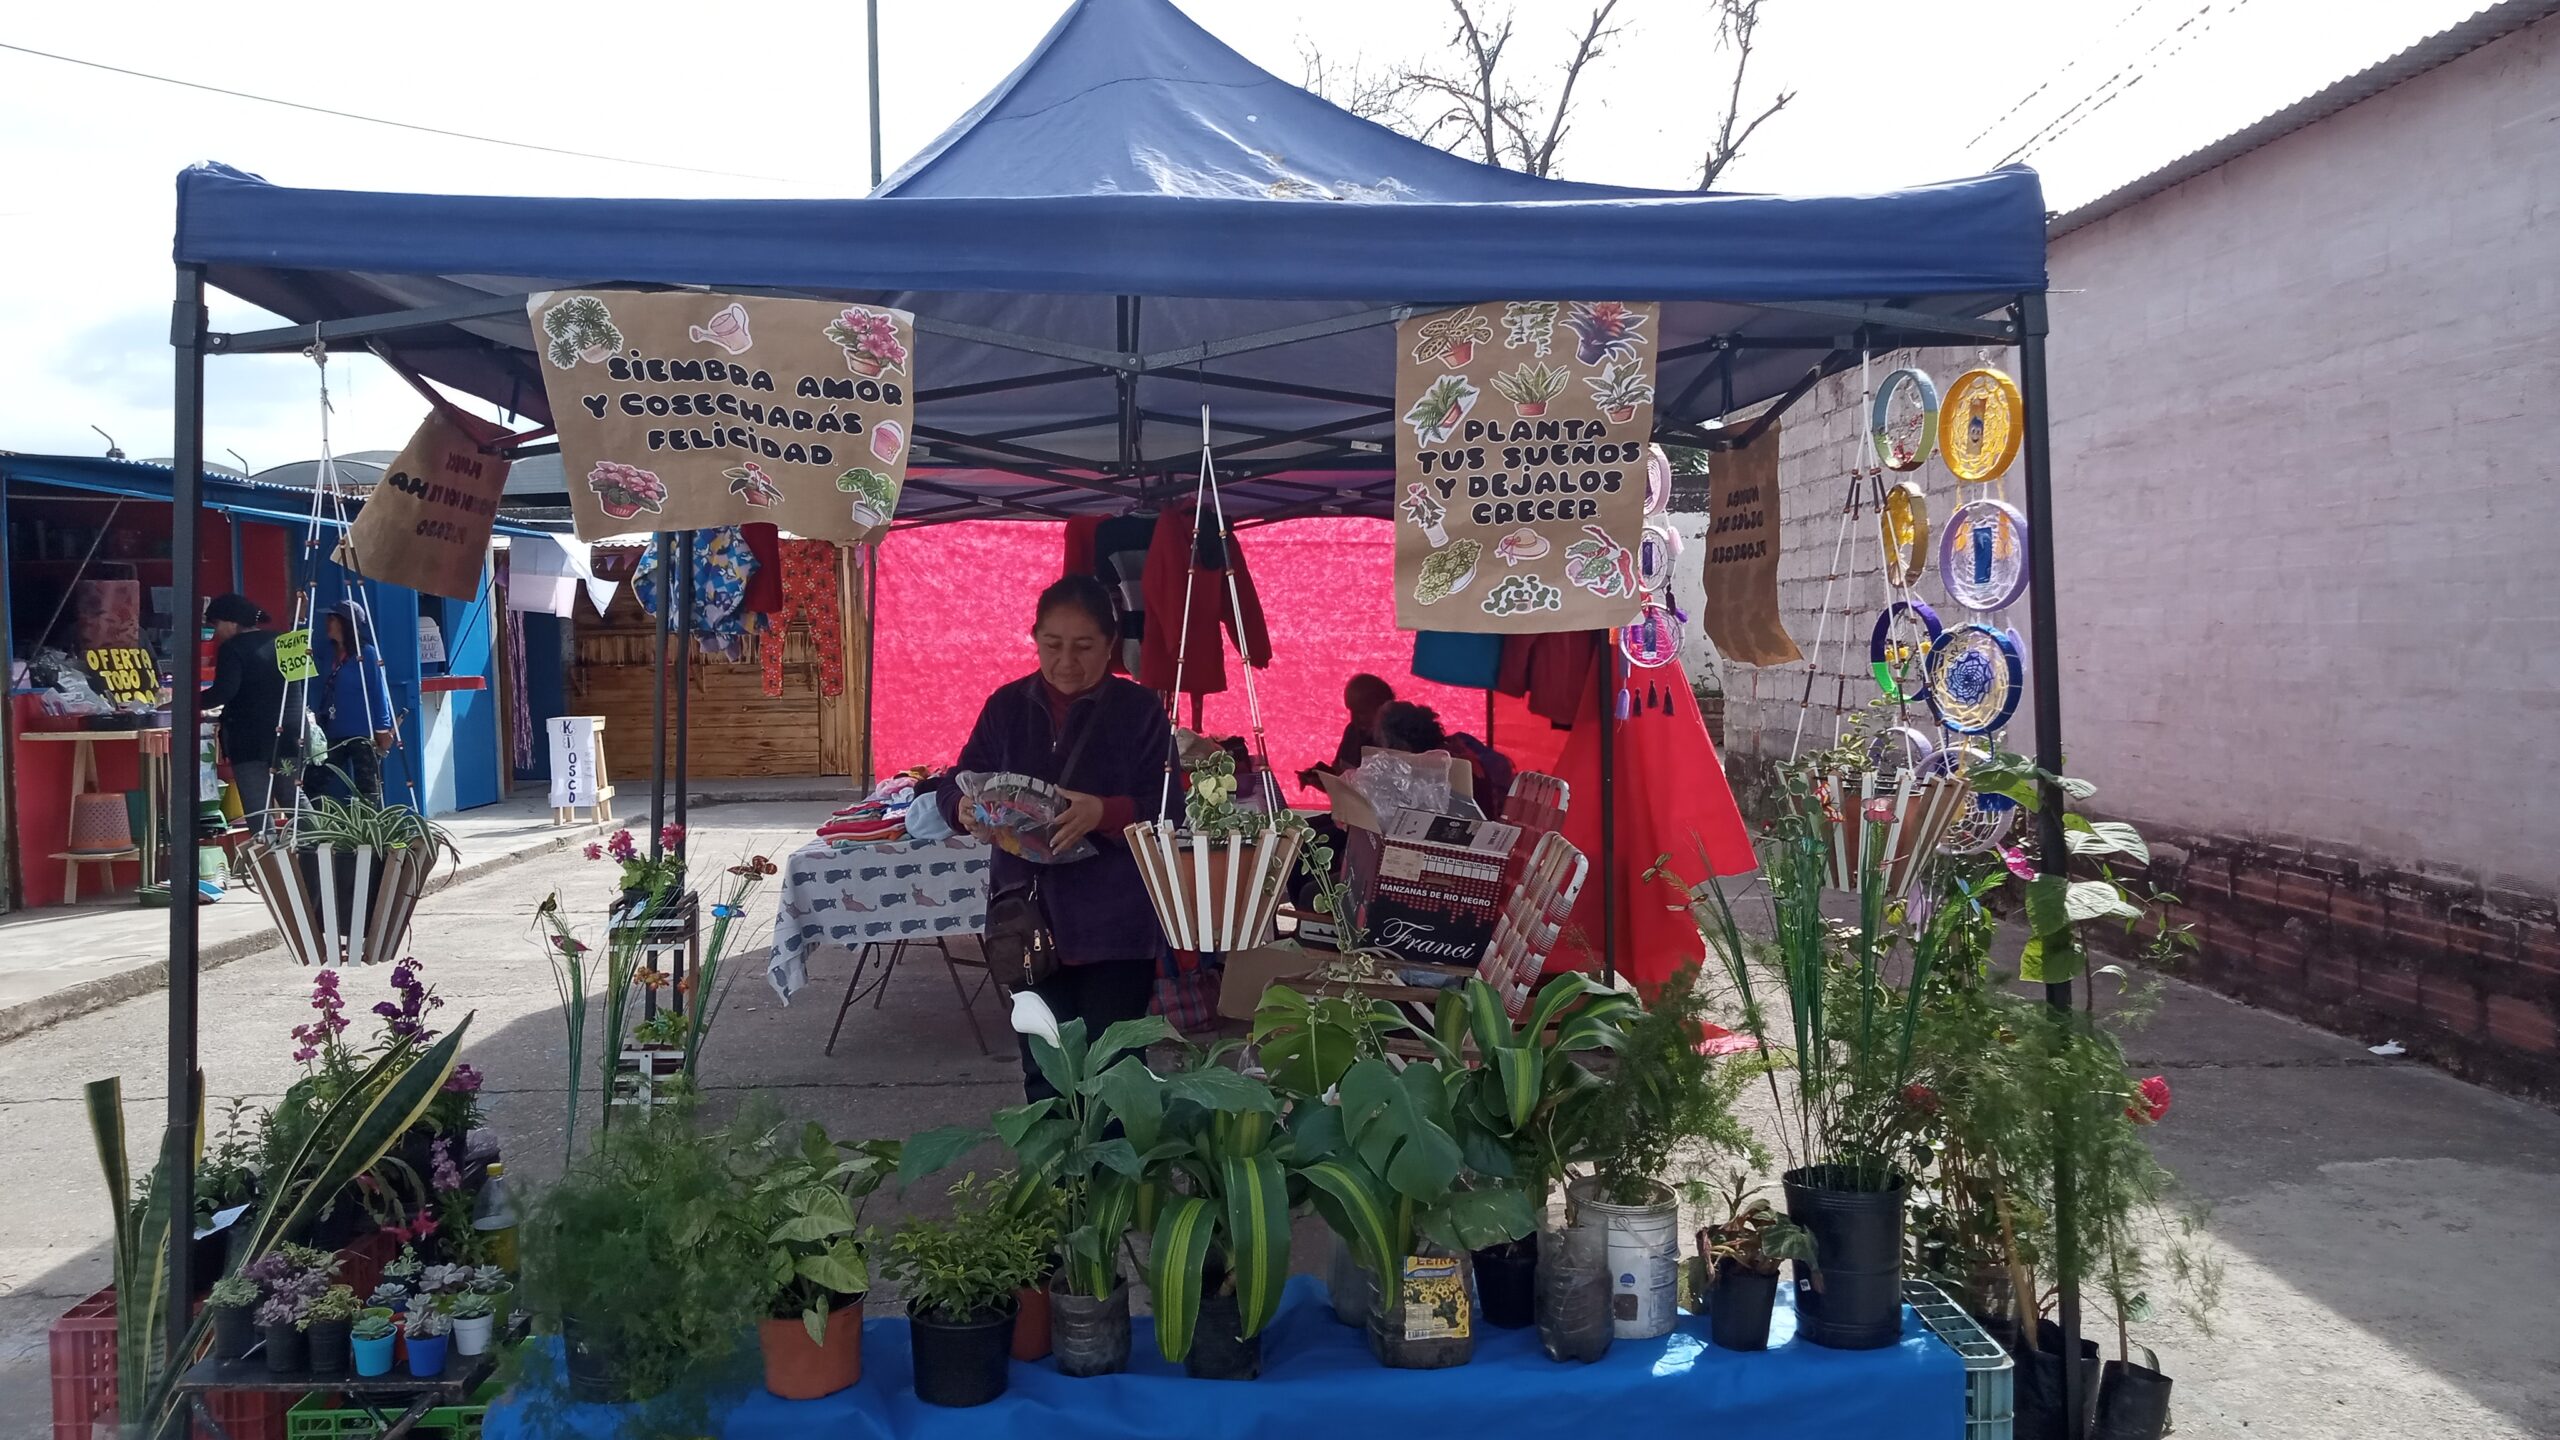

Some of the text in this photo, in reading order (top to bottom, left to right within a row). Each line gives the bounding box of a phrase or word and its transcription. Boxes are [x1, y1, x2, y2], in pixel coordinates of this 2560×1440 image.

[795, 375, 904, 406] AMOR
[581, 392, 864, 435] Y COSECHARÁS
[1463, 419, 1608, 444] PLANTA
[1416, 441, 1641, 475] TUS SUEÑOS
[1434, 465, 1624, 500] Y DEJALOS
[86, 648, 152, 671] OFERTA
[99, 669, 160, 691] TODO X
[562, 720, 577, 804] KIOSCO
[1380, 883, 1491, 907] MANZANAS DE RIO NEGRO
[1374, 917, 1477, 960] Franci
